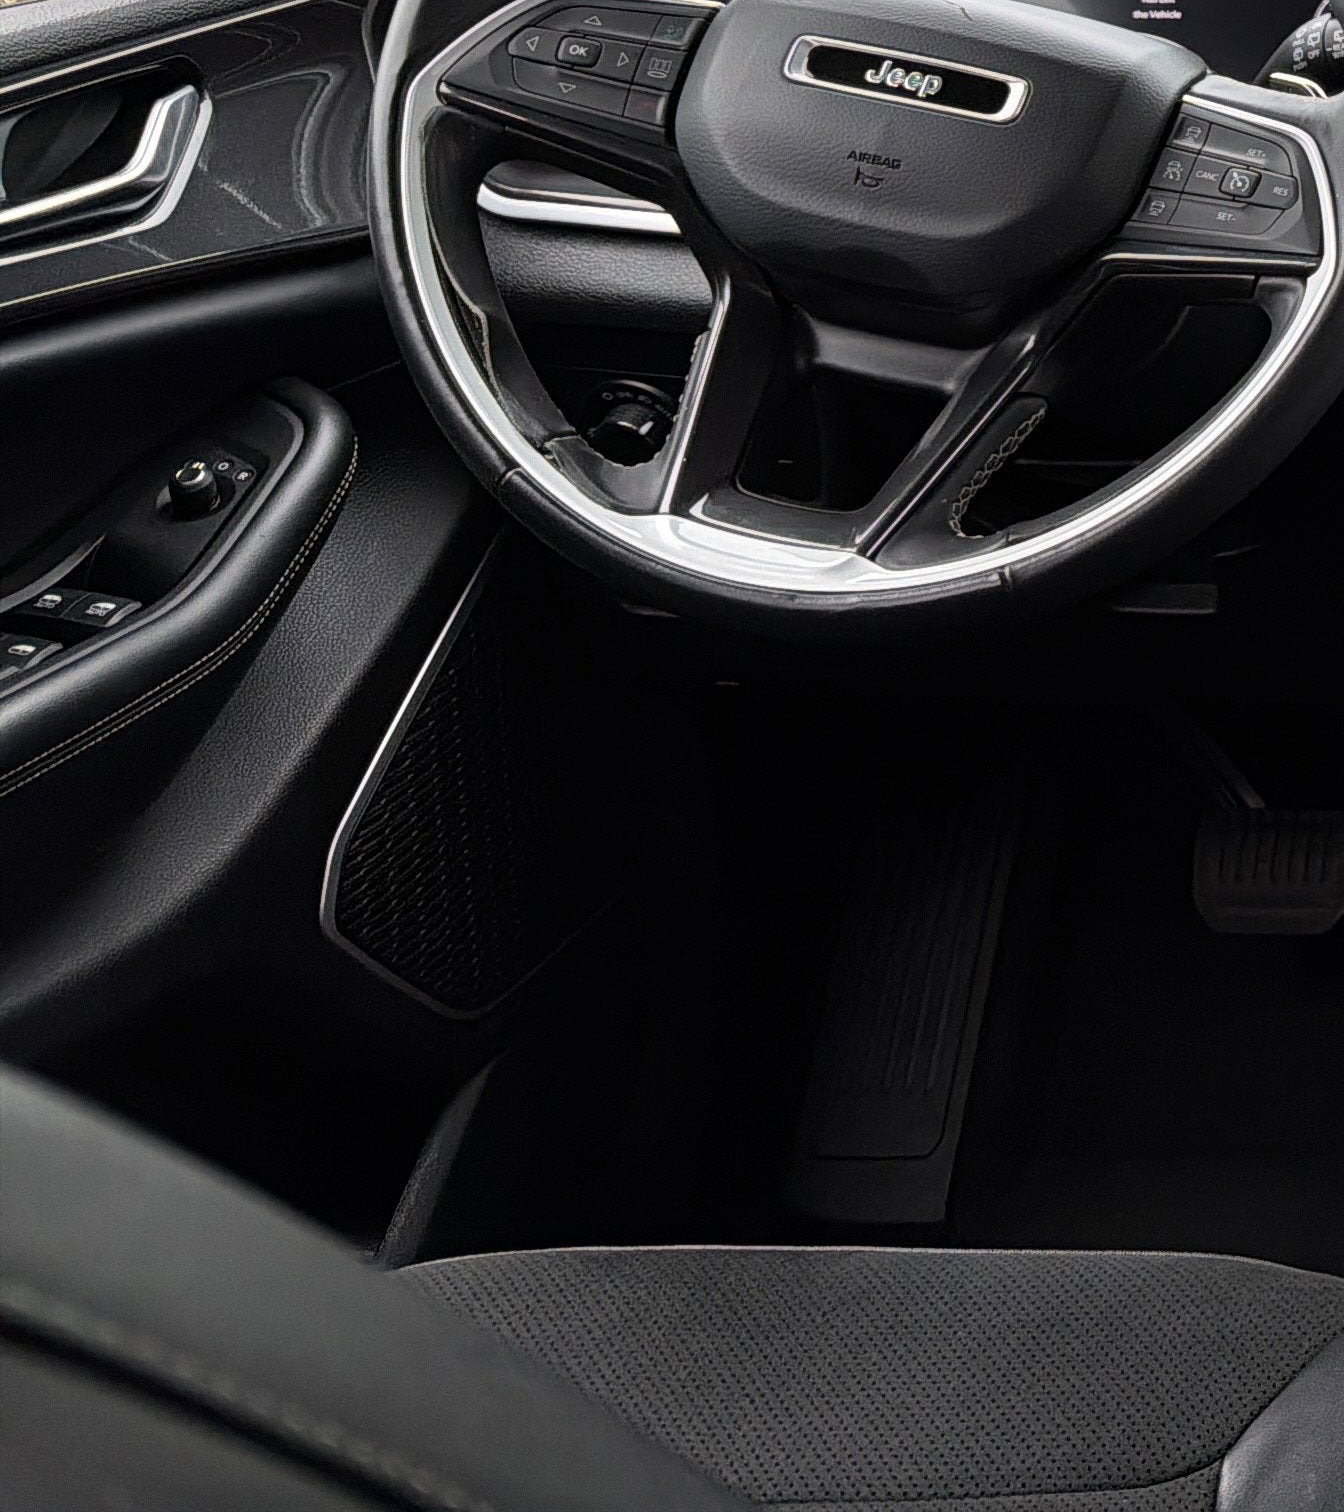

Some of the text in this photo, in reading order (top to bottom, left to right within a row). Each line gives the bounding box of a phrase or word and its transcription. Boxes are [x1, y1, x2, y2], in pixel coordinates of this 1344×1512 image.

[1132, 10, 1182, 19] the Vehicle
[569, 44, 589, 56] OK
[864, 60, 943, 97] Jeep
[846, 150, 903, 170] AIRBAG
[1196, 170, 1219, 182] CANC
[1272, 186, 1289, 196] RES
